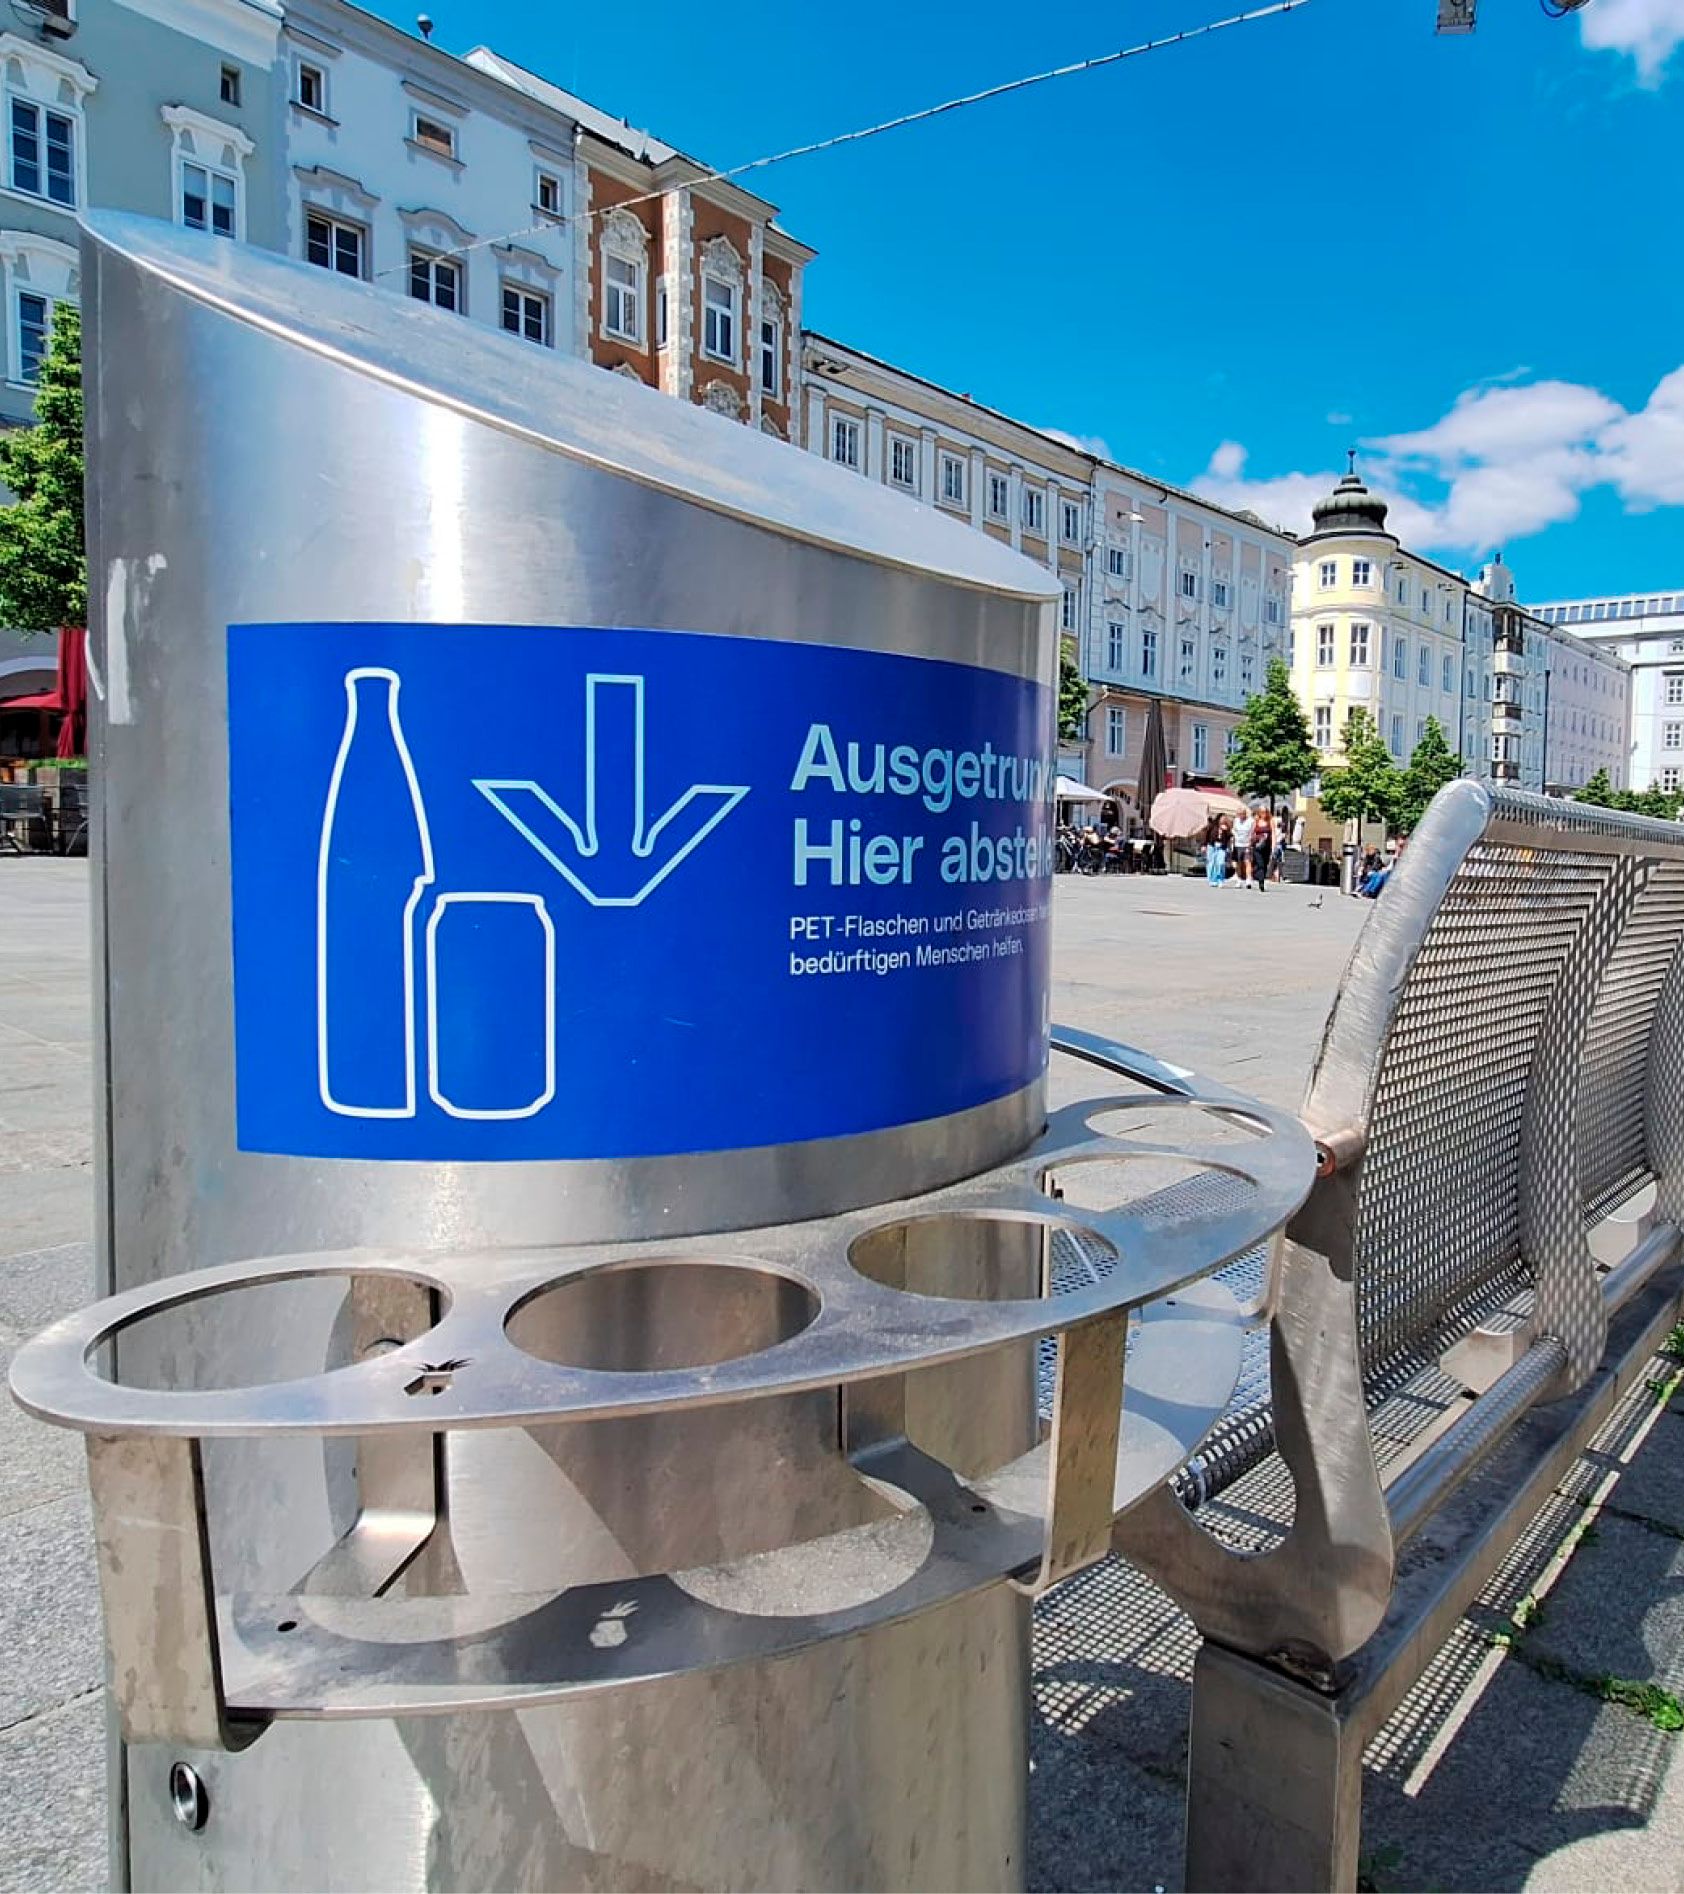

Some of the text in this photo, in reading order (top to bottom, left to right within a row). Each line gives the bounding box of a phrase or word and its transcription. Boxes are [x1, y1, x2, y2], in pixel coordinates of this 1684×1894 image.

[793, 817, 924, 887] Hier
[789, 913, 929, 941] PET-Flaschen
[933, 909, 963, 932] und
[789, 948, 911, 976] bedürftigen
[915, 940, 990, 967] Menschen
